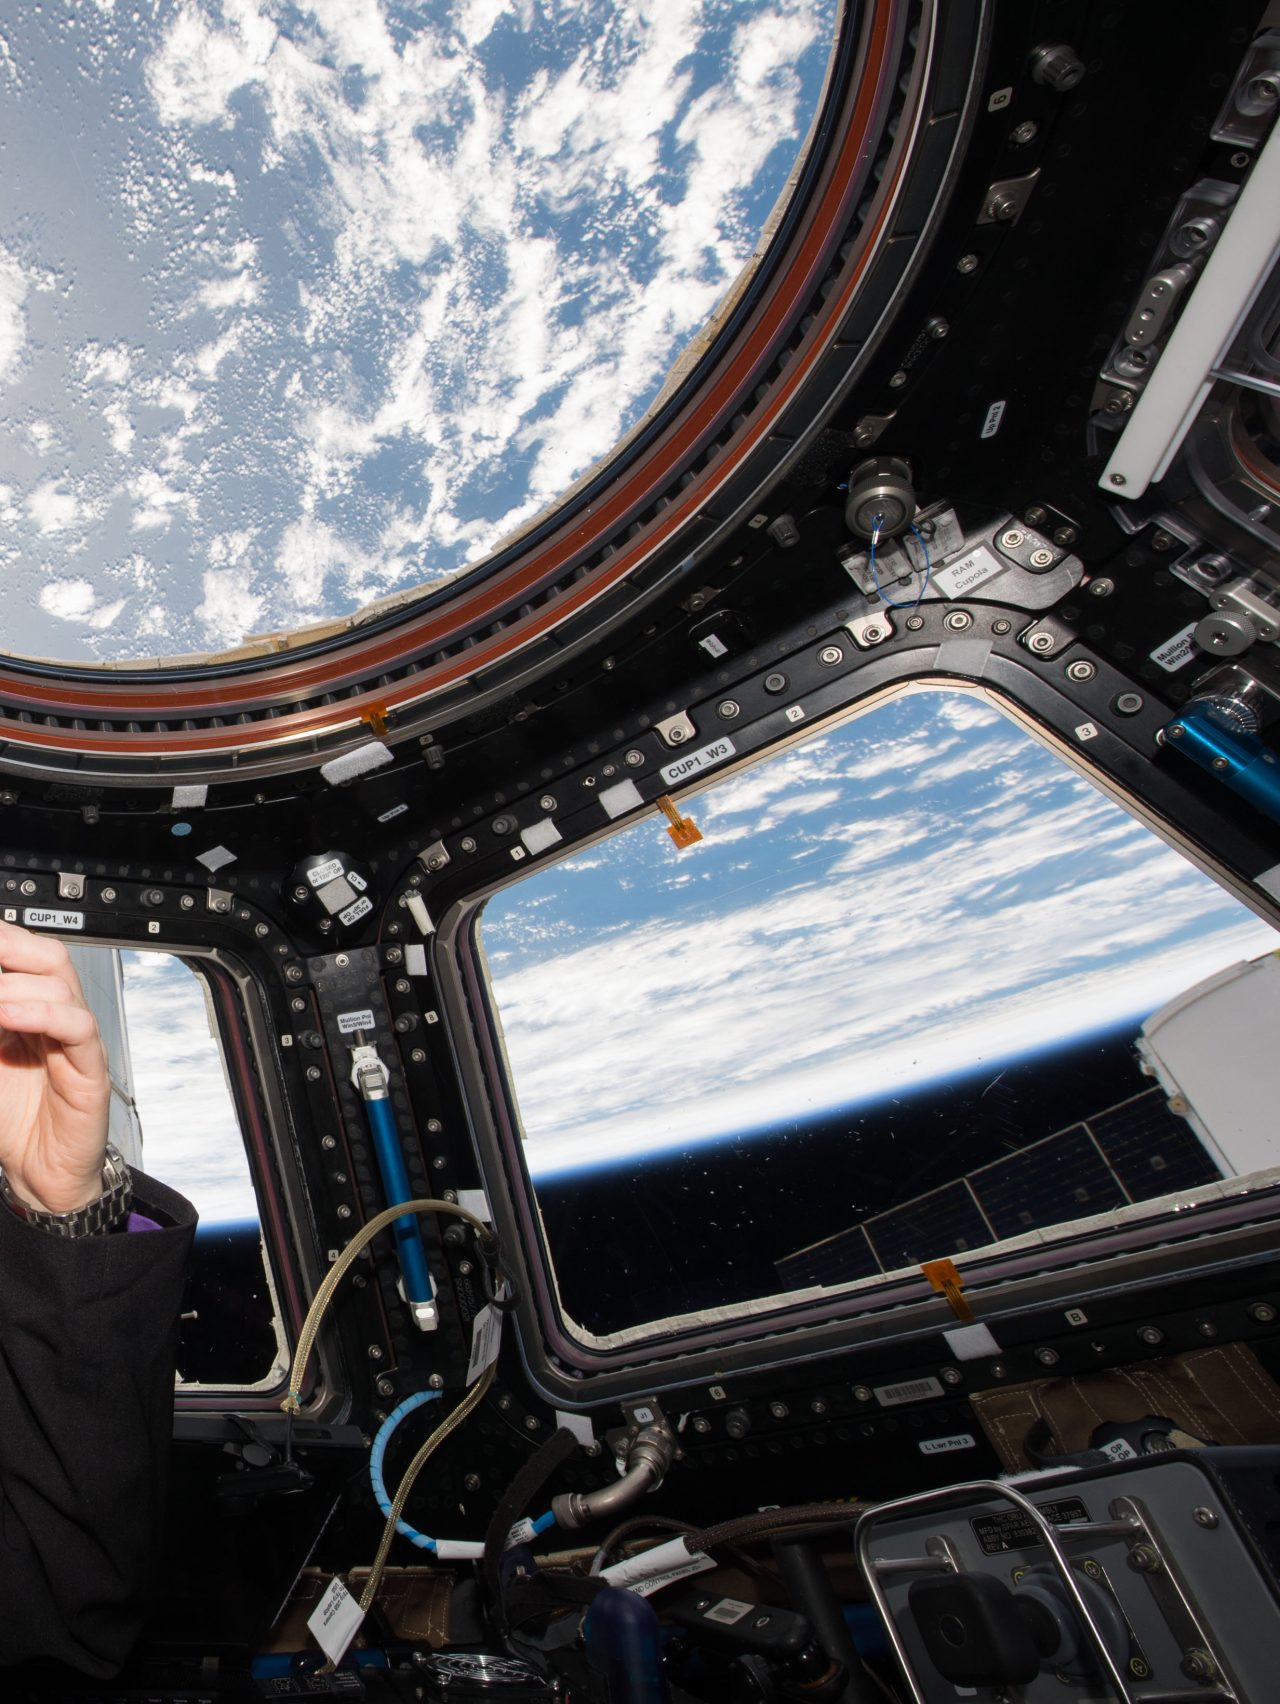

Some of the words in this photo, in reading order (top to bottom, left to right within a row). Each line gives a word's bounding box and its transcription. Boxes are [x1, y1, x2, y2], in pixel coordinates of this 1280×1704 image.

[951, 559, 975, 578] RAM
[954, 566, 989, 590] Cupola
[1157, 639, 1188, 661] Mullion
[791, 710, 799, 718] 2
[1082, 727, 1091, 736] 3
[668, 744, 728, 779] CUP1_W3
[29, 912, 78, 925] CUP1_W4
[713, 1388, 721, 1396] 6
[948, 1439, 961, 1447] Pnl
[1110, 1443, 1121, 1453] OP
[1118, 1449, 1130, 1460] OP
[1002, 1541, 1009, 1549] A
